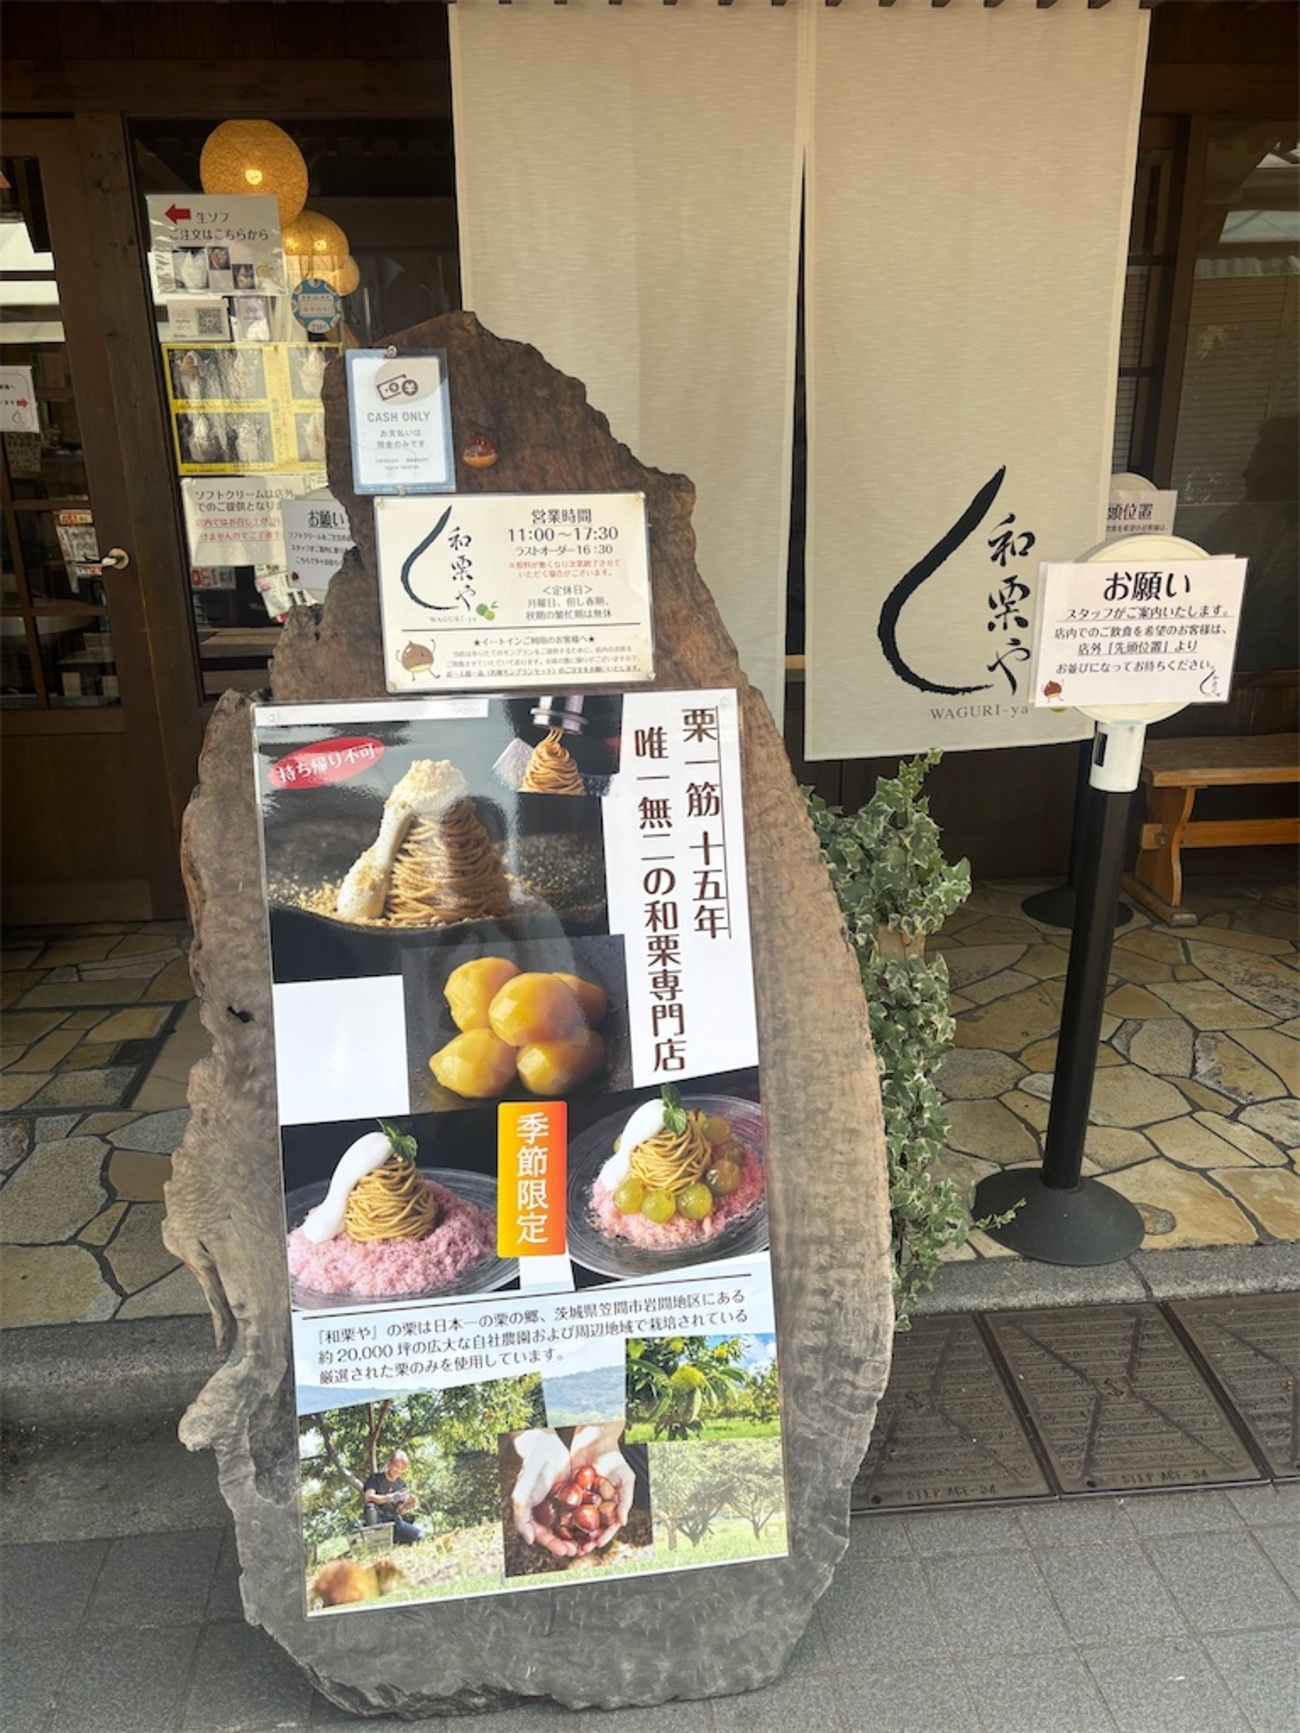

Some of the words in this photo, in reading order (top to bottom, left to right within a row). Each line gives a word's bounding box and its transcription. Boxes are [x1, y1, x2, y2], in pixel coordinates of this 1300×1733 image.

[169, 229, 269, 241] ご注文はこちらから
[367, 412, 398, 422] CASH
[402, 411, 431, 422] ONLY
[308, 510, 345, 528] お願い
[531, 508, 592, 525] 営業時間
[448, 526, 477, 612] 和栗や
[1103, 570, 1191, 603] お願い
[987, 513, 1036, 696] 和栗や
[1067, 604, 1231, 619] スタッフがご案内いたします。
[1055, 624, 1228, 640] 店内でのご飲食を希望のお客様は、
[1056, 659, 1216, 675] お並びになってお待ちください。
[930, 704, 1029, 720] WAGURI-ya
[276, 743, 377, 784] 持ち帰り不可
[634, 726, 687, 1073] 唯一無二の和栗専門店
[516, 1112, 550, 1245] 季節限定
[319, 1347, 564, 1386] 厳選された栗のみを使用しています。
